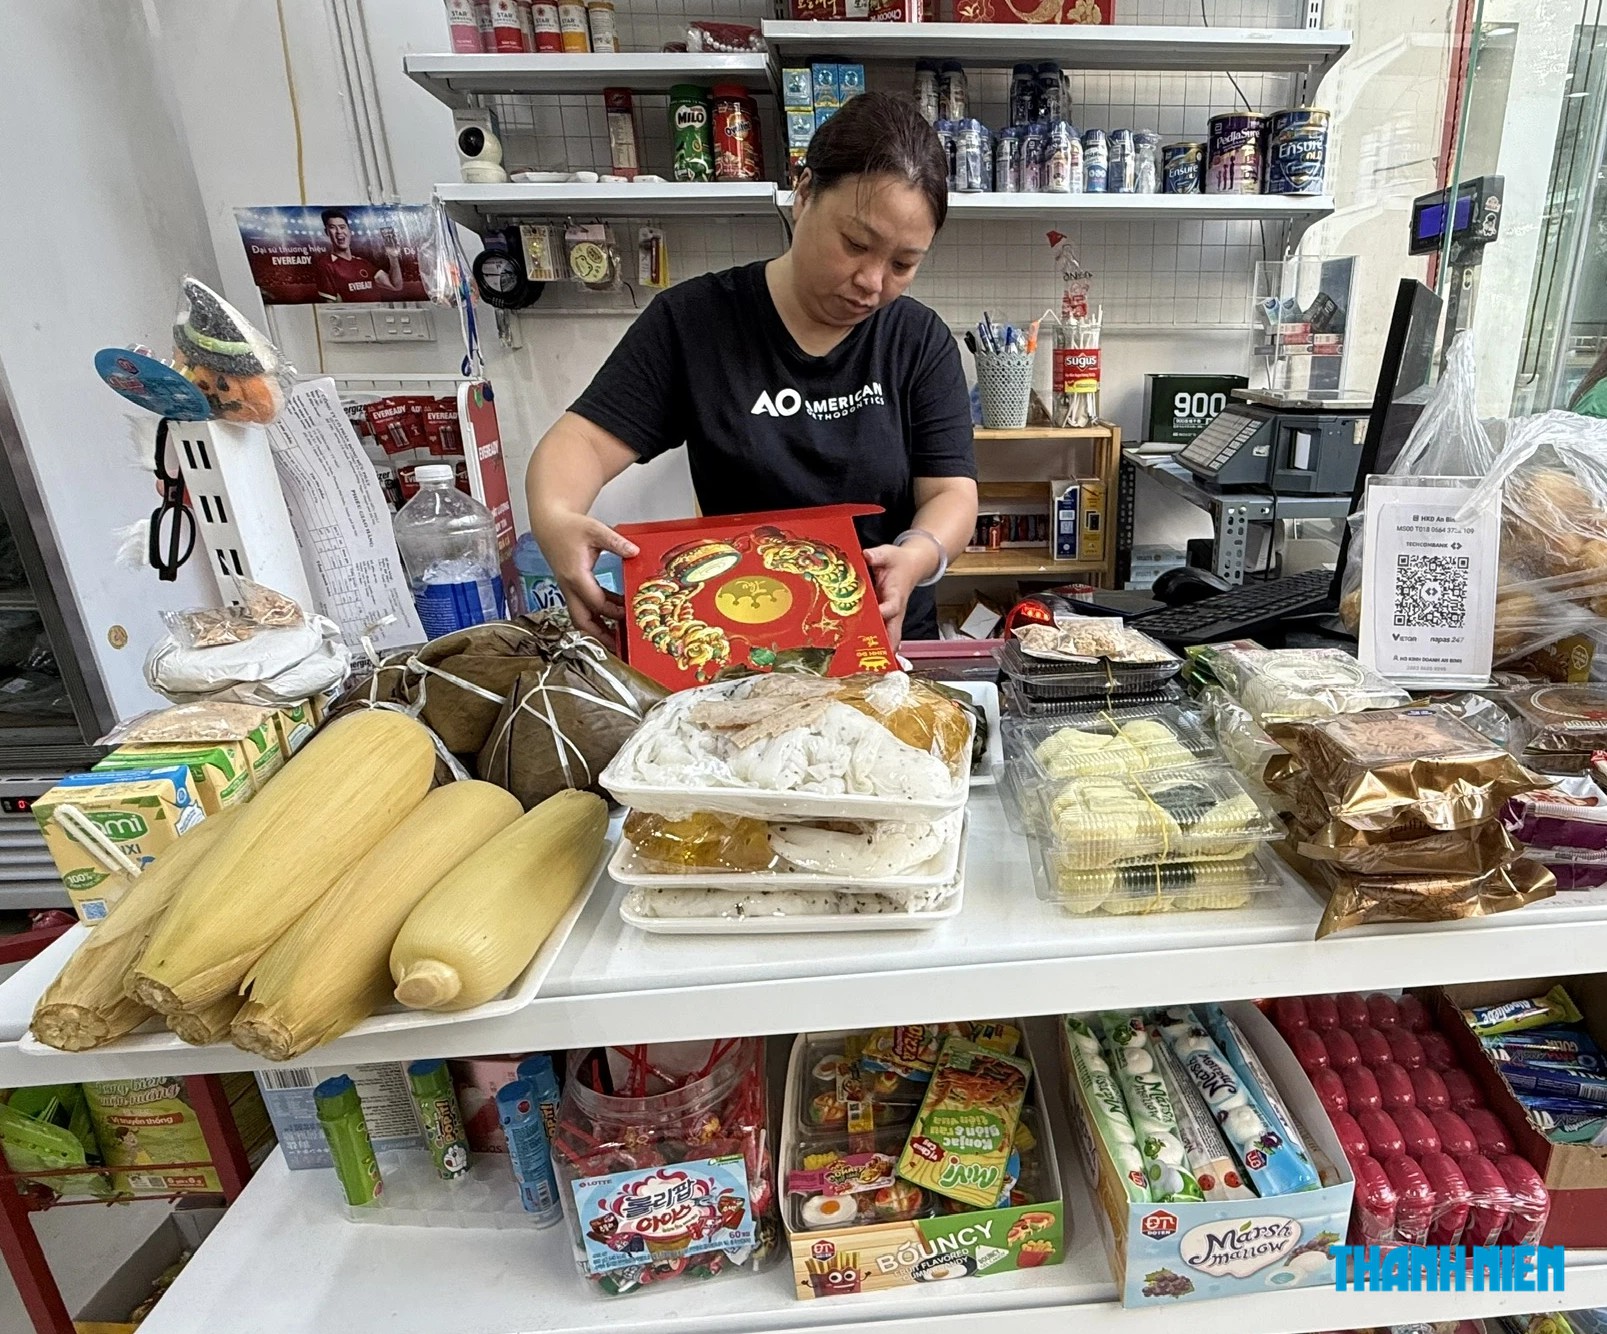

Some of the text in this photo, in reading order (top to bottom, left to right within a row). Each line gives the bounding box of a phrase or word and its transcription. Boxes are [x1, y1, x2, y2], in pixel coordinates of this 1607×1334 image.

[677, 112, 705, 124] MILO
[1279, 140, 1323, 158] Ensure
[1169, 164, 1198, 178] Ensure
[272, 256, 312, 265] EVEREADY
[1065, 356, 1097, 369] sugus
[751, 382, 883, 417] AO AMERICAN
[1174, 392, 1226, 417] 900
[372, 405, 407, 420] EVEREADY
[427, 412, 458, 421] EVEREAD
[89, 815, 143, 837] ami
[943, 1136, 993, 1150] Konjac
[587, 1179, 613, 1187] LOTTE
[636, 1204, 692, 1233] 아이스
[921, 1248, 970, 1270] FLAVORED
